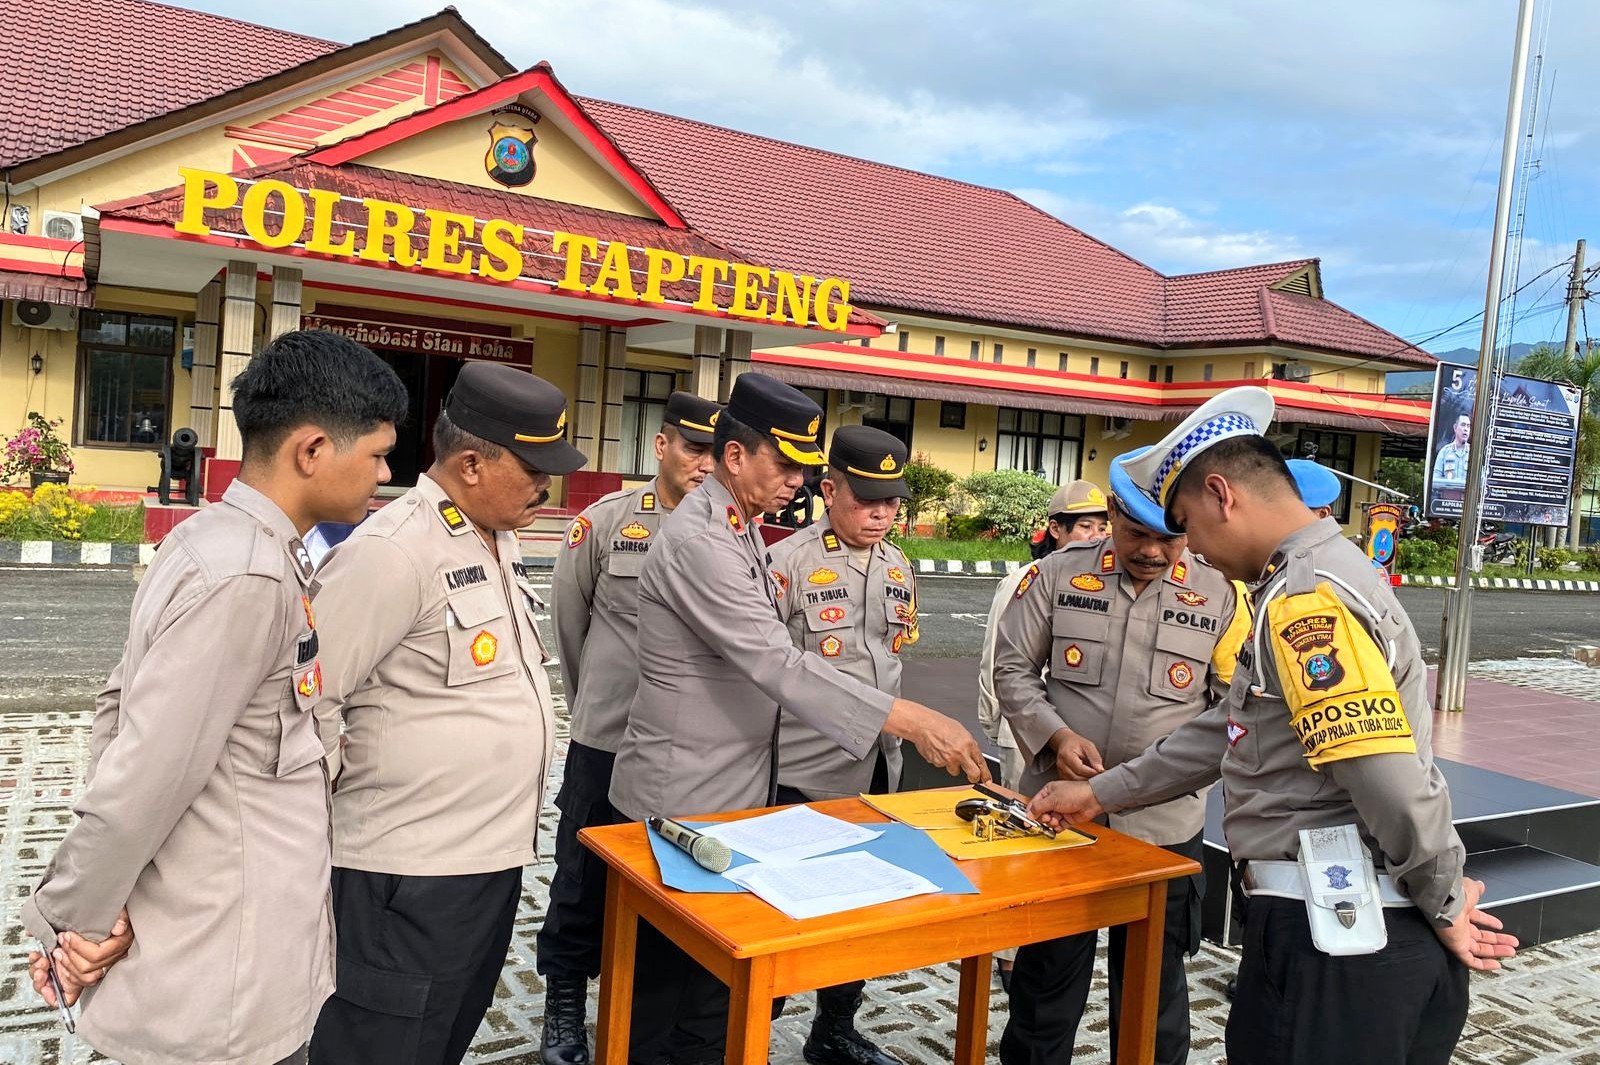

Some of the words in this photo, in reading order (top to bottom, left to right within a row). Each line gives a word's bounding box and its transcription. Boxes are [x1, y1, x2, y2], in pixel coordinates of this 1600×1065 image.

[175, 166, 525, 283] POLRES
[550, 230, 851, 332] TAPTENG
[422, 331, 463, 354] Sian
[1451, 370, 1463, 390] 5
[613, 540, 652, 553] S.SIREGA
[806, 593, 818, 604] TH
[1163, 609, 1217, 632] POLRI
[1287, 617, 1328, 634] POLRES
[1327, 722, 1357, 741] PRAJA
[1357, 717, 1383, 733] TOBA
